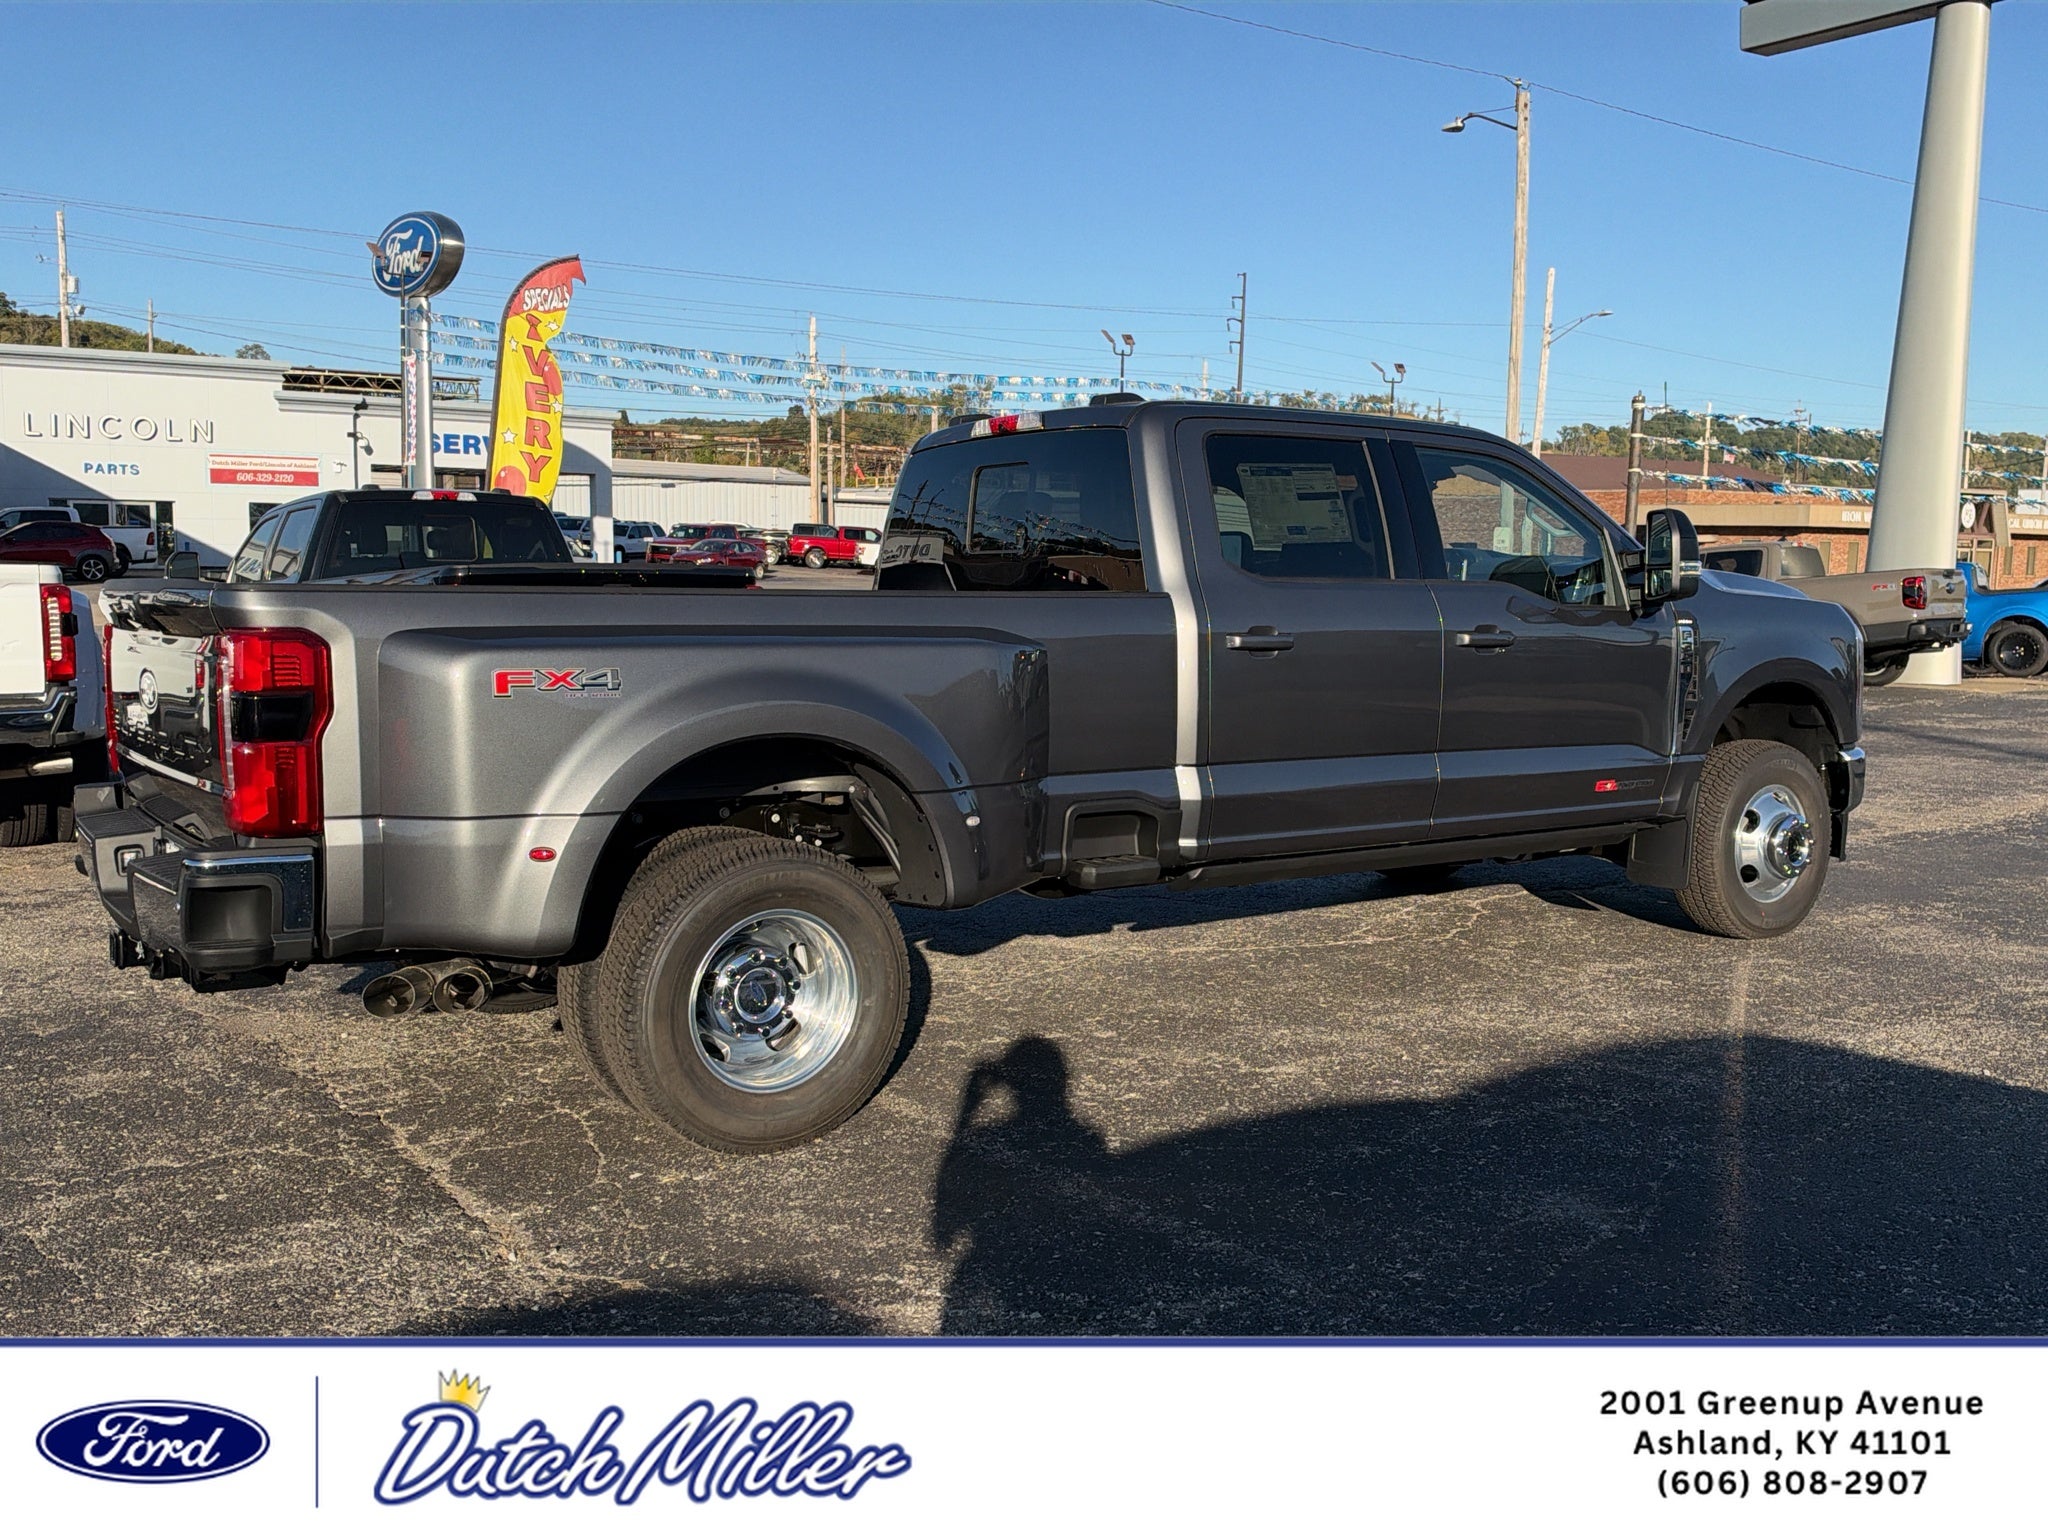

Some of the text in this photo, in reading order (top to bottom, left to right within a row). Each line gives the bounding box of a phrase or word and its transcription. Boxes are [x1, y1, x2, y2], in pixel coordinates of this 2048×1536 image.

[382, 228, 424, 282] Ford
[522, 283, 570, 312] SPECIALS
[23, 411, 215, 443] LINCOLN
[83, 462, 140, 476] PARTS
[236, 472, 294, 483] 606-329-2120
[1841, 510, 1862, 522] IRON
[491, 667, 622, 699] FX4
